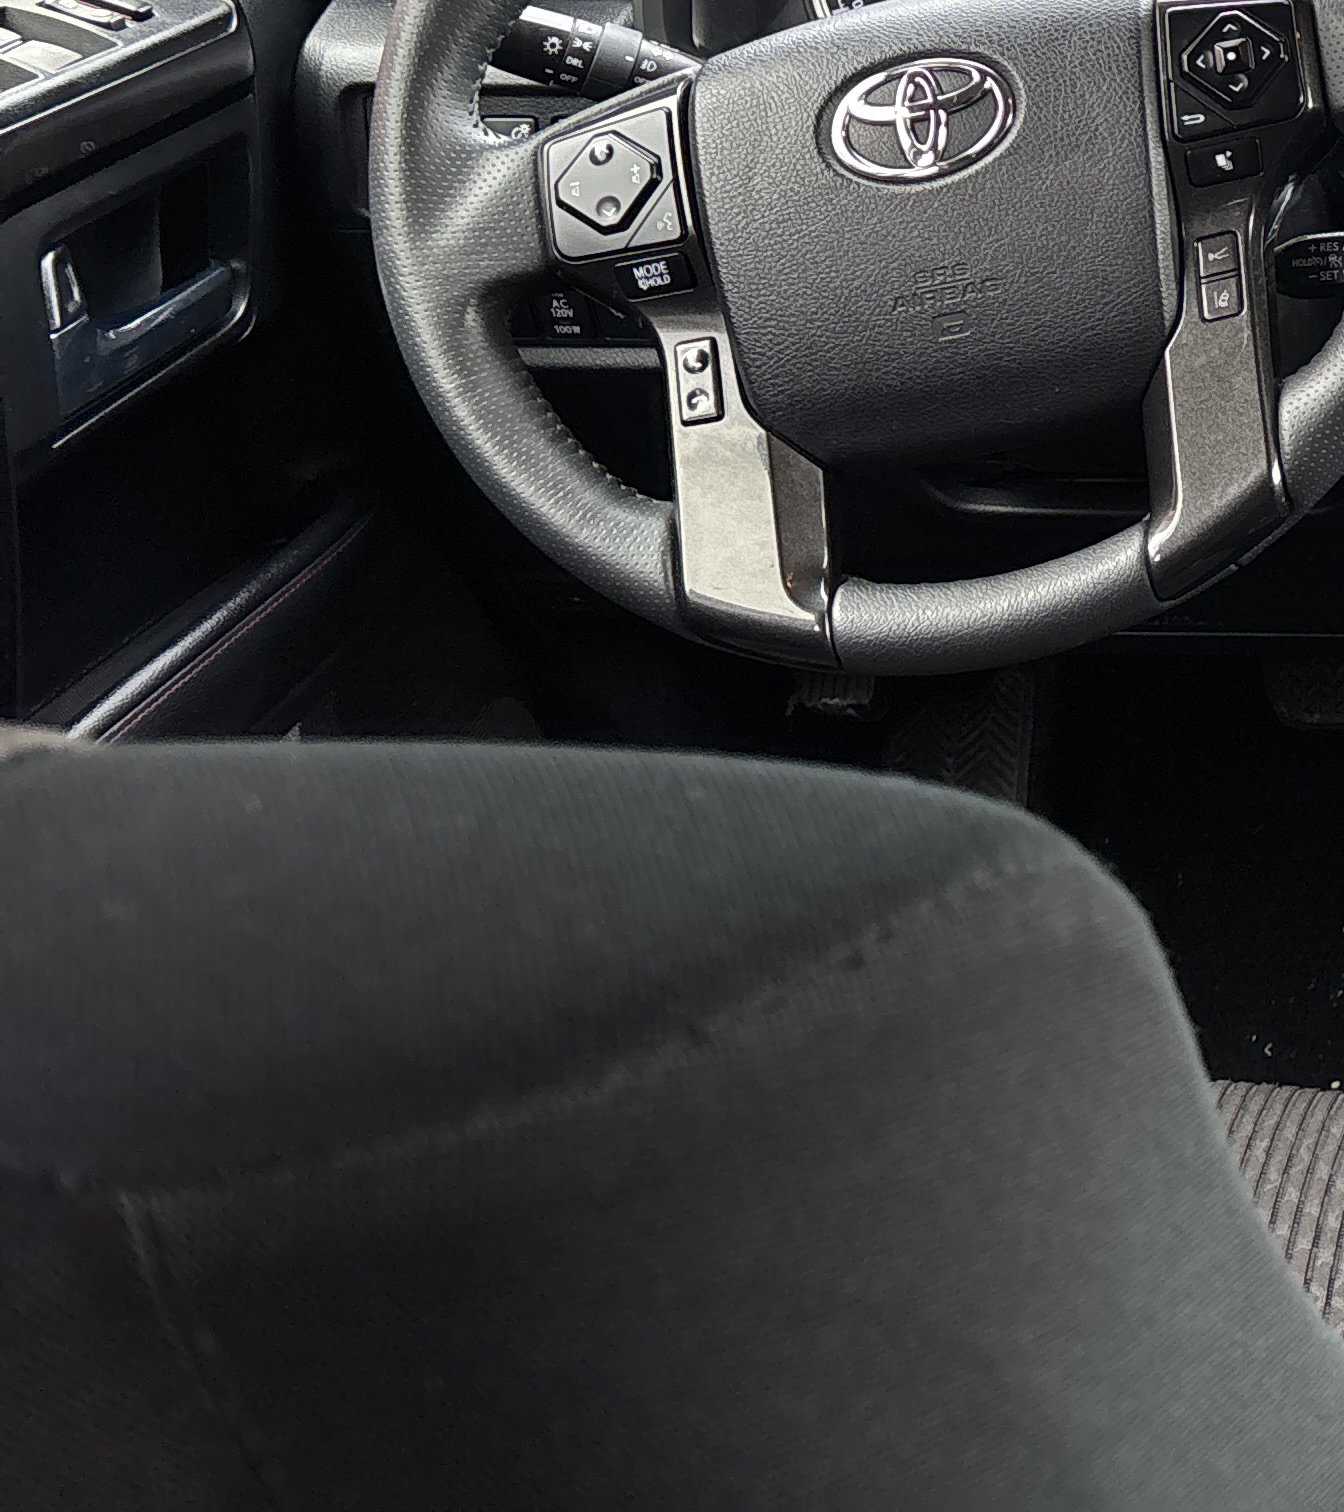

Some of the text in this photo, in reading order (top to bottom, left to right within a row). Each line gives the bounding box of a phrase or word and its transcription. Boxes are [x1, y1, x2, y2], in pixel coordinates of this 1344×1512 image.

[565, 55, 585, 69] DRL
[559, 72, 579, 83] OFF
[1319, 242, 1340, 253] RES
[633, 260, 670, 281] MODE
[1319, 270, 1340, 281] SET
[552, 298, 570, 309] AC
[550, 307, 574, 319] 120V
